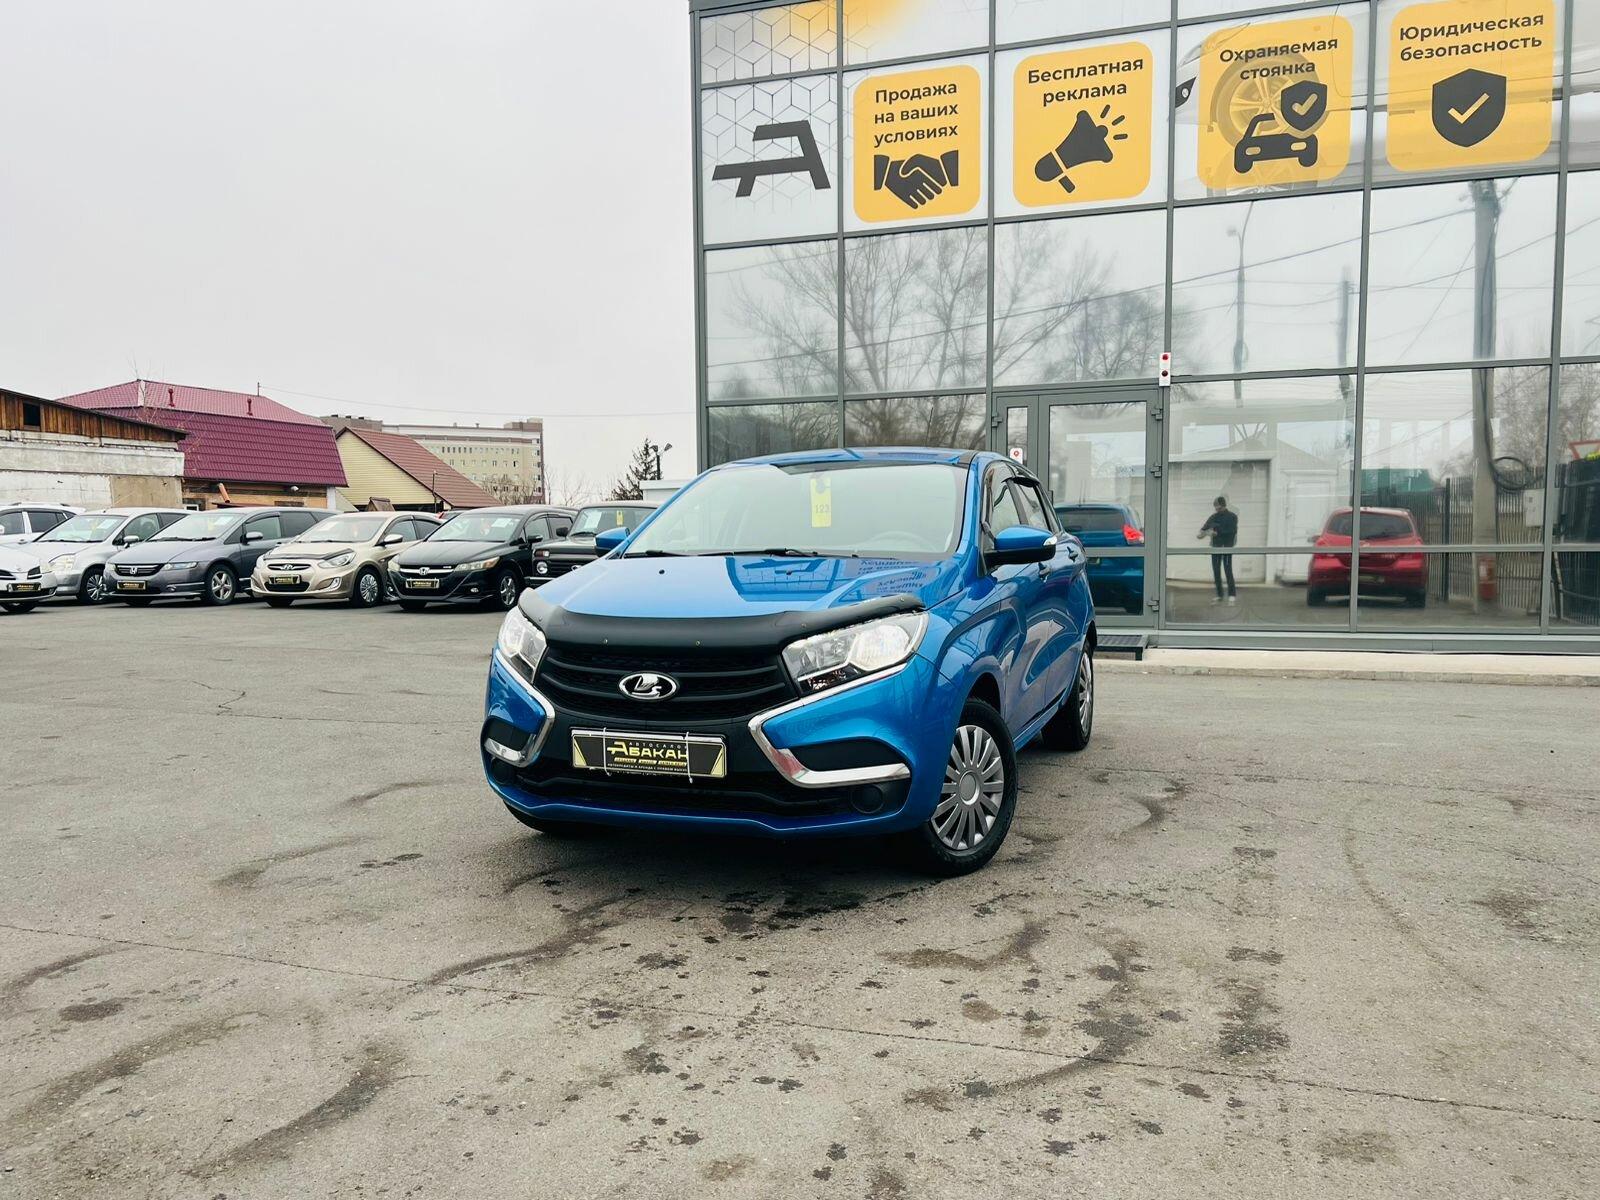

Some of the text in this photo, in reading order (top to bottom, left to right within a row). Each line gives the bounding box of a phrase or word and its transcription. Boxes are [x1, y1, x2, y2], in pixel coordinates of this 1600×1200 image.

[1400, 14, 1544, 43] Юридическая
[1219, 38, 1338, 64] Охраняемая
[1400, 36, 1542, 62] безопасность
[1028, 58, 1143, 84] Бесплатная
[1239, 62, 1316, 81] стоянка
[875, 83, 957, 105] Продажа
[1043, 83, 1127, 108] реклама
[874, 104, 959, 124] на ваших
[873, 125, 958, 149] условиях
